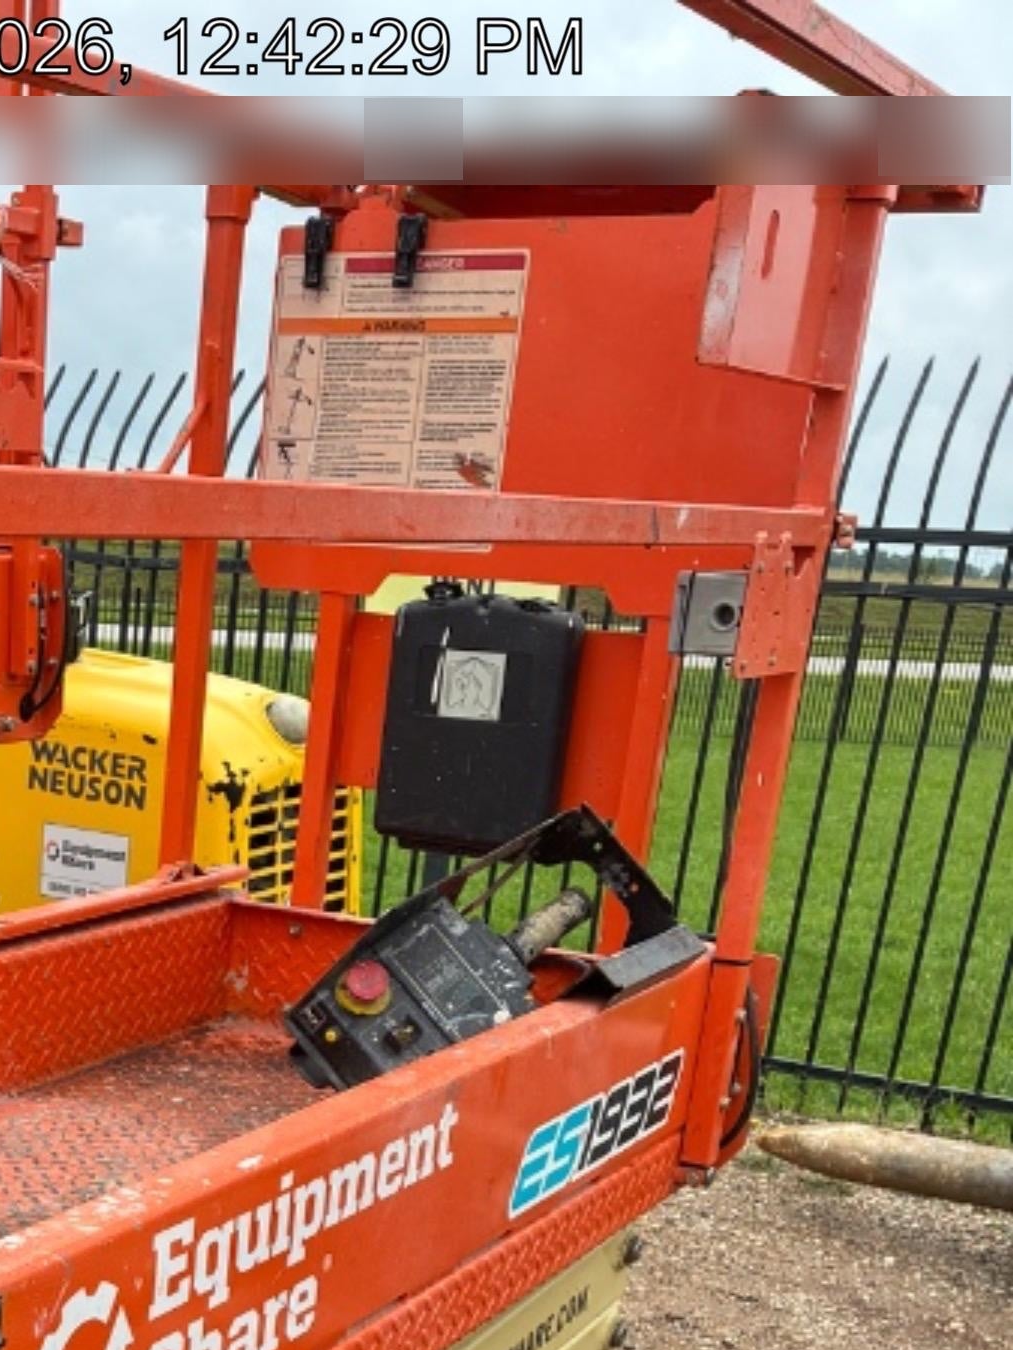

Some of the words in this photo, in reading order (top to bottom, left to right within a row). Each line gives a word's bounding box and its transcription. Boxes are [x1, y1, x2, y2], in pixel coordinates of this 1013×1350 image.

[27, 765, 147, 811] NEUSON
[29, 738, 147, 783] WACKER
[509, 1049, 684, 1219] ES1932
[148, 1102, 459, 1321] Equipment
